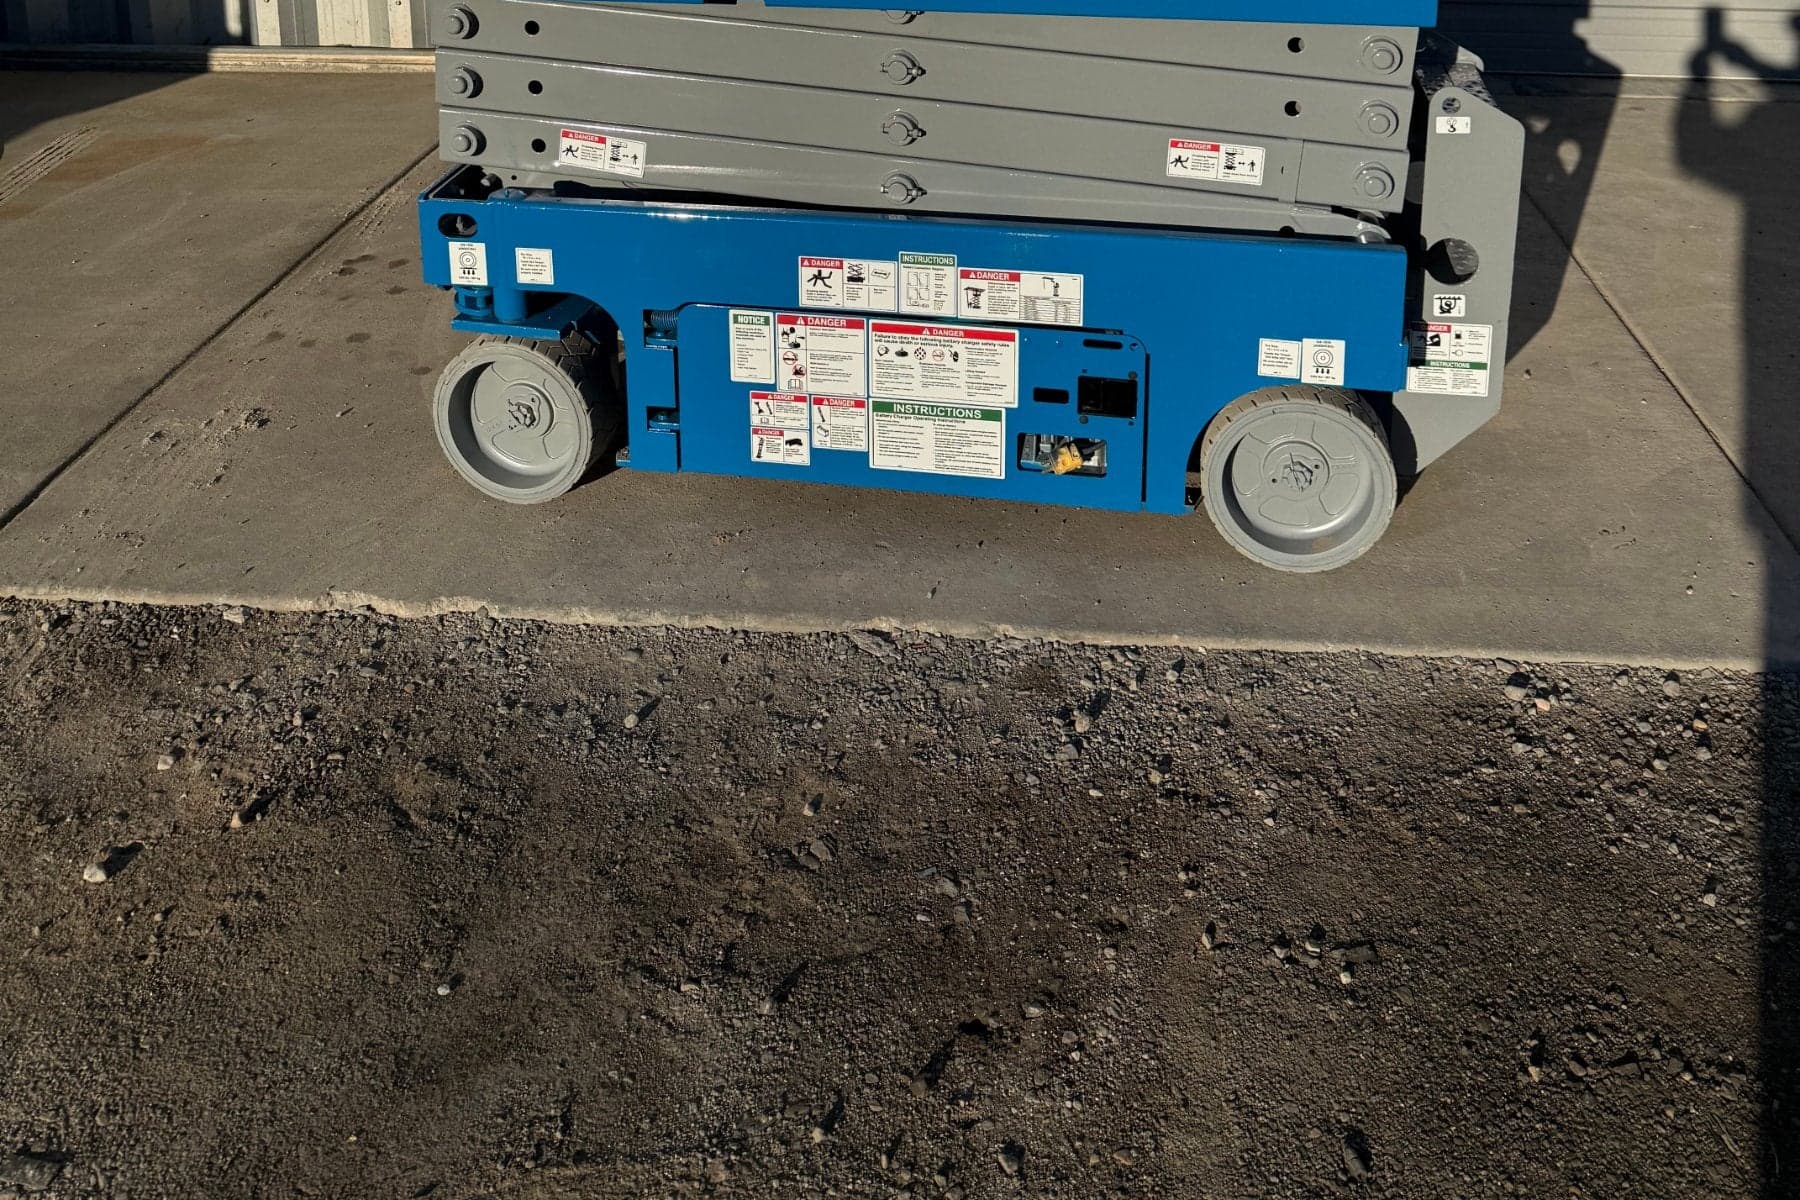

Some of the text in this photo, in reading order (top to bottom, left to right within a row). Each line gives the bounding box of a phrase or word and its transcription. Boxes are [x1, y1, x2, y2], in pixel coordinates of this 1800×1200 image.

[574, 132, 599, 142] DANGER
[1184, 142, 1211, 150] DANGER
[811, 259, 840, 268] DANGER
[902, 255, 954, 265] INSTRUCTIONS
[976, 272, 1010, 280] DANGER
[738, 316, 765, 325] NOTICE
[808, 317, 847, 327] DANGER
[932, 328, 964, 338] DANGER
[1430, 360, 1470, 368] INSTRUCTIONS
[830, 399, 855, 407] DANGER
[893, 403, 982, 419] INSTRUCTIONS
